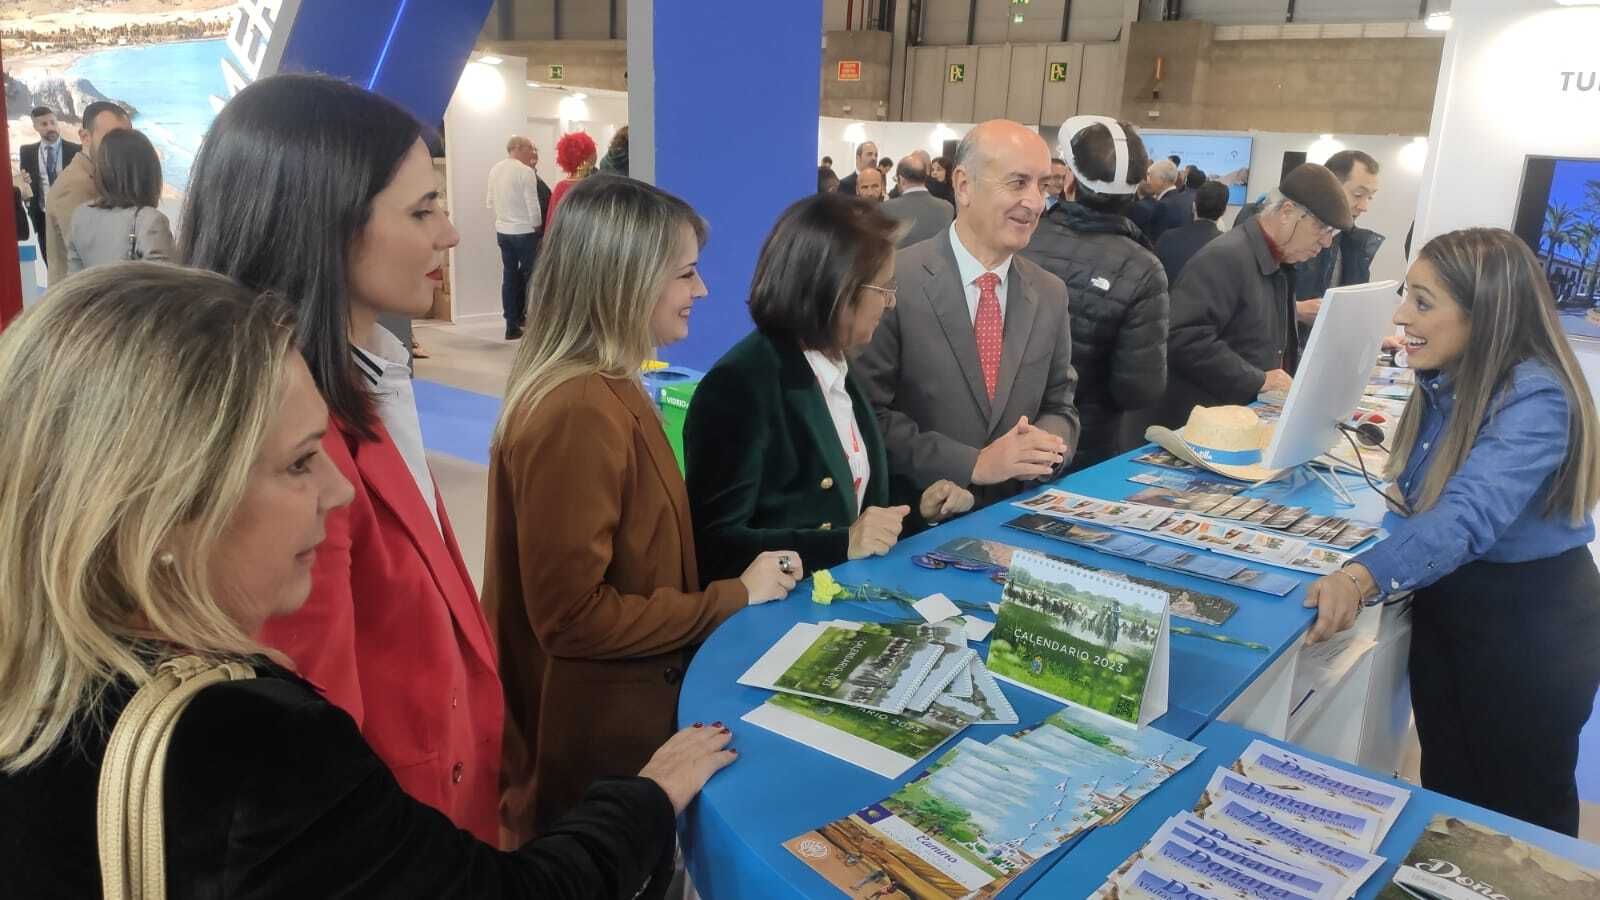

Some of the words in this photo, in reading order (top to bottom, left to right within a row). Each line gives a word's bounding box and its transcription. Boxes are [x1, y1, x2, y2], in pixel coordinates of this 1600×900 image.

[1560, 71, 1600, 91] TU
[1014, 628, 1089, 661] CALENDARIO
[1093, 655, 1124, 673] 2023
[916, 833, 958, 863] Camino
